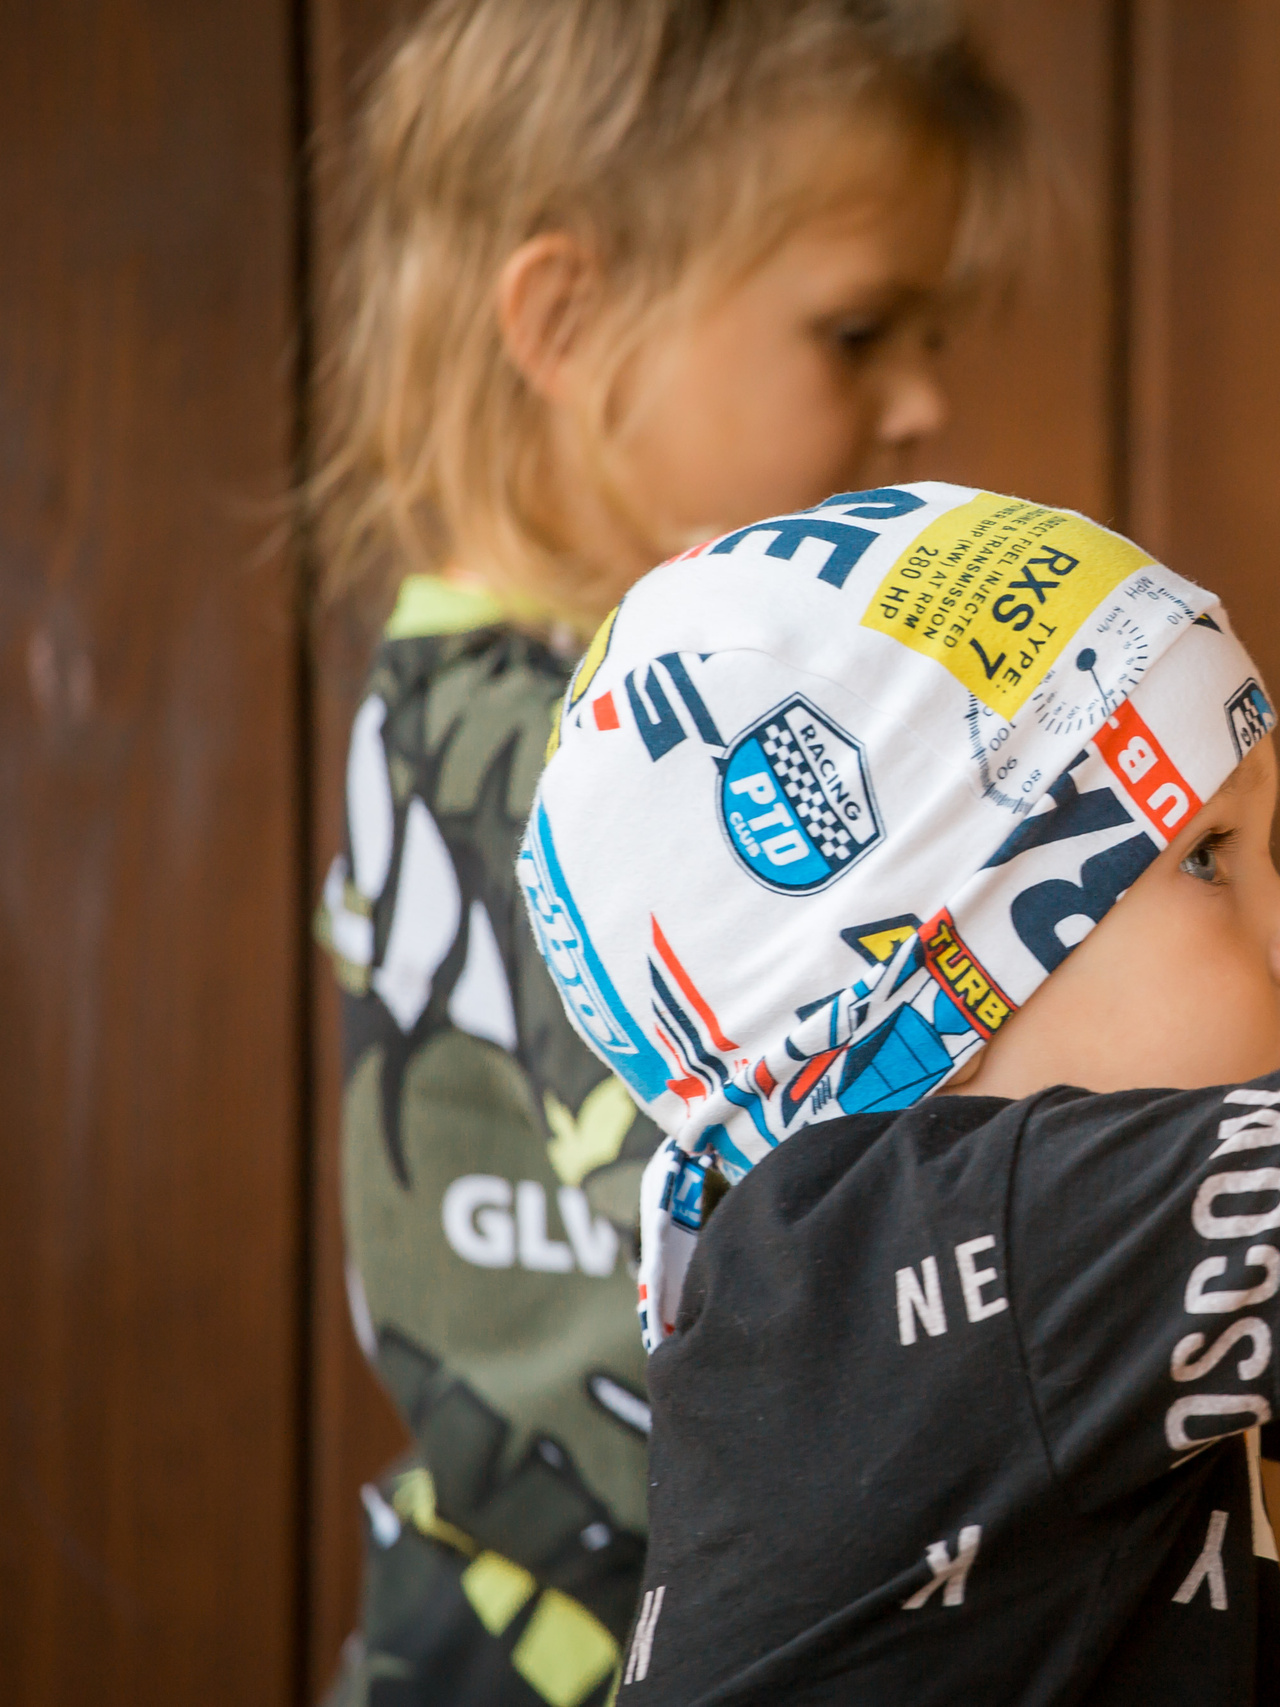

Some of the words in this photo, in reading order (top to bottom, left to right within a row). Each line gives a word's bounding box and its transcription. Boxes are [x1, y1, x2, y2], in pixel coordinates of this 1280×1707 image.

[970, 519, 997, 538] BHP
[900, 545, 939, 579] 280
[939, 538, 973, 568] (KW)
[998, 537, 1033, 566] FUEL
[923, 534, 1008, 640] TRANSMISSION
[927, 570, 947, 589] AT
[992, 544, 1081, 632] RXS
[1124, 576, 1155, 600] MPH
[880, 586, 910, 619] HP
[903, 592, 934, 629] RPM
[943, 570, 1004, 648] INJECTED
[1166, 611, 1184, 626] 10
[968, 637, 1007, 680] 7
[996, 622, 1057, 694] TYPE:
[800, 724, 861, 822] RACING
[729, 771, 810, 866] PTD
[729, 812, 762, 858] CLUB
[929, 919, 1016, 1032] TURB
[895, 1235, 1008, 1347] NE
